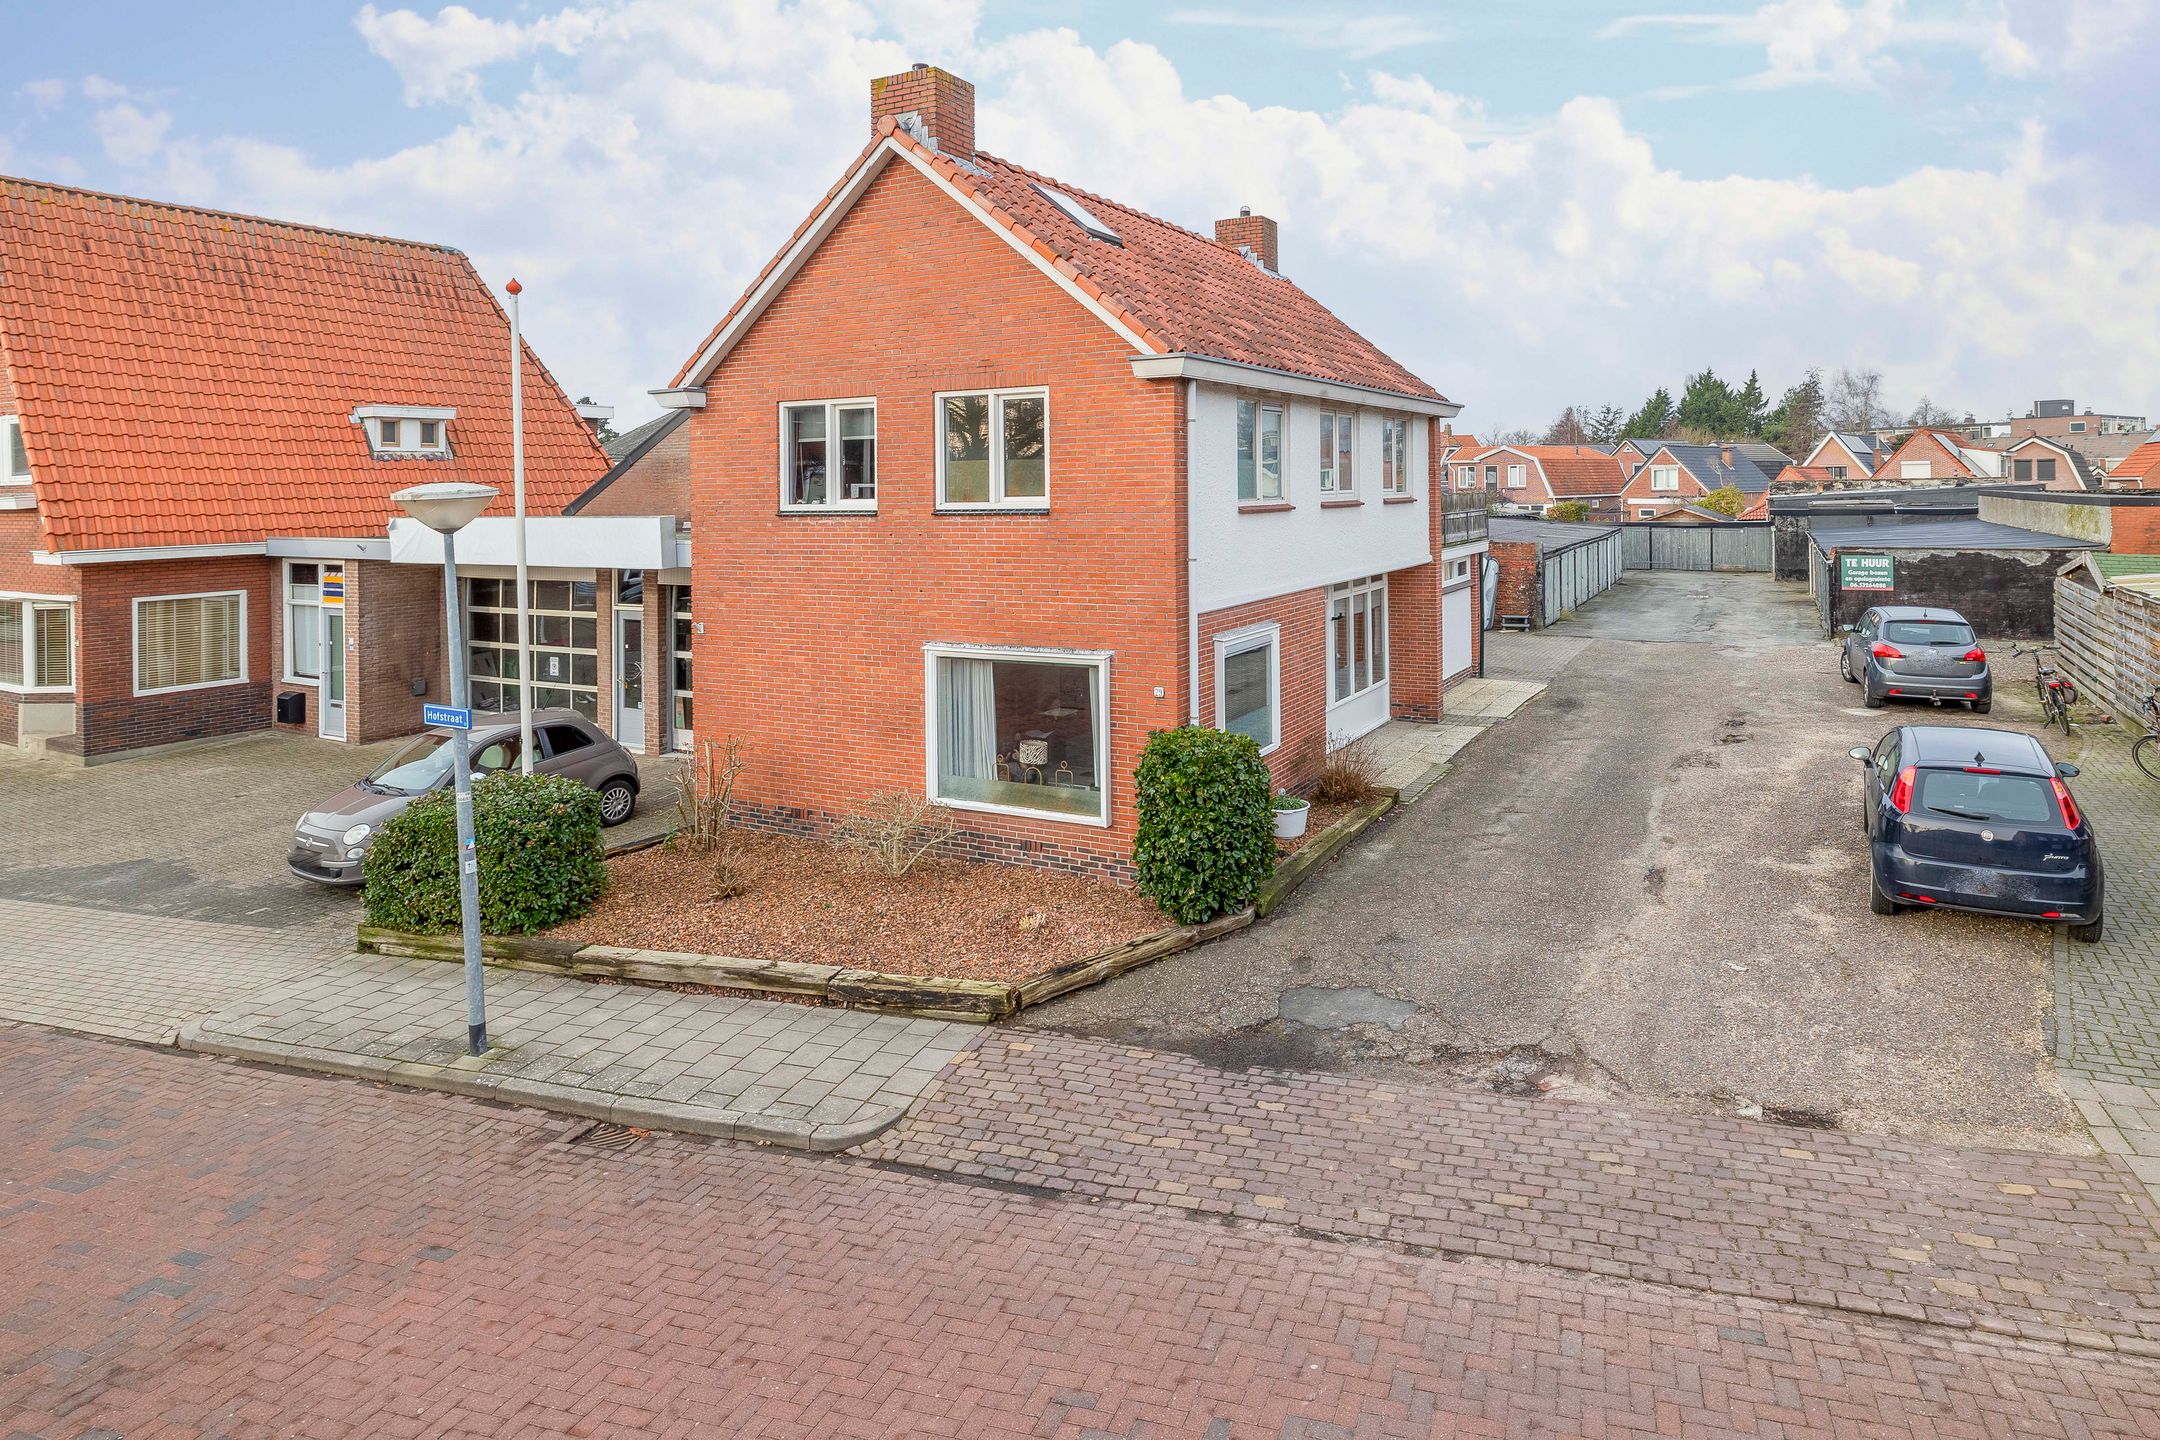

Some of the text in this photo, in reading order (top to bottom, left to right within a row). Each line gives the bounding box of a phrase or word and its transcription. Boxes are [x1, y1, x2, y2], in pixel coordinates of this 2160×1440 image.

[1845, 558, 1890, 568] TE HUUR
[427, 710, 463, 724] Hofstraat
